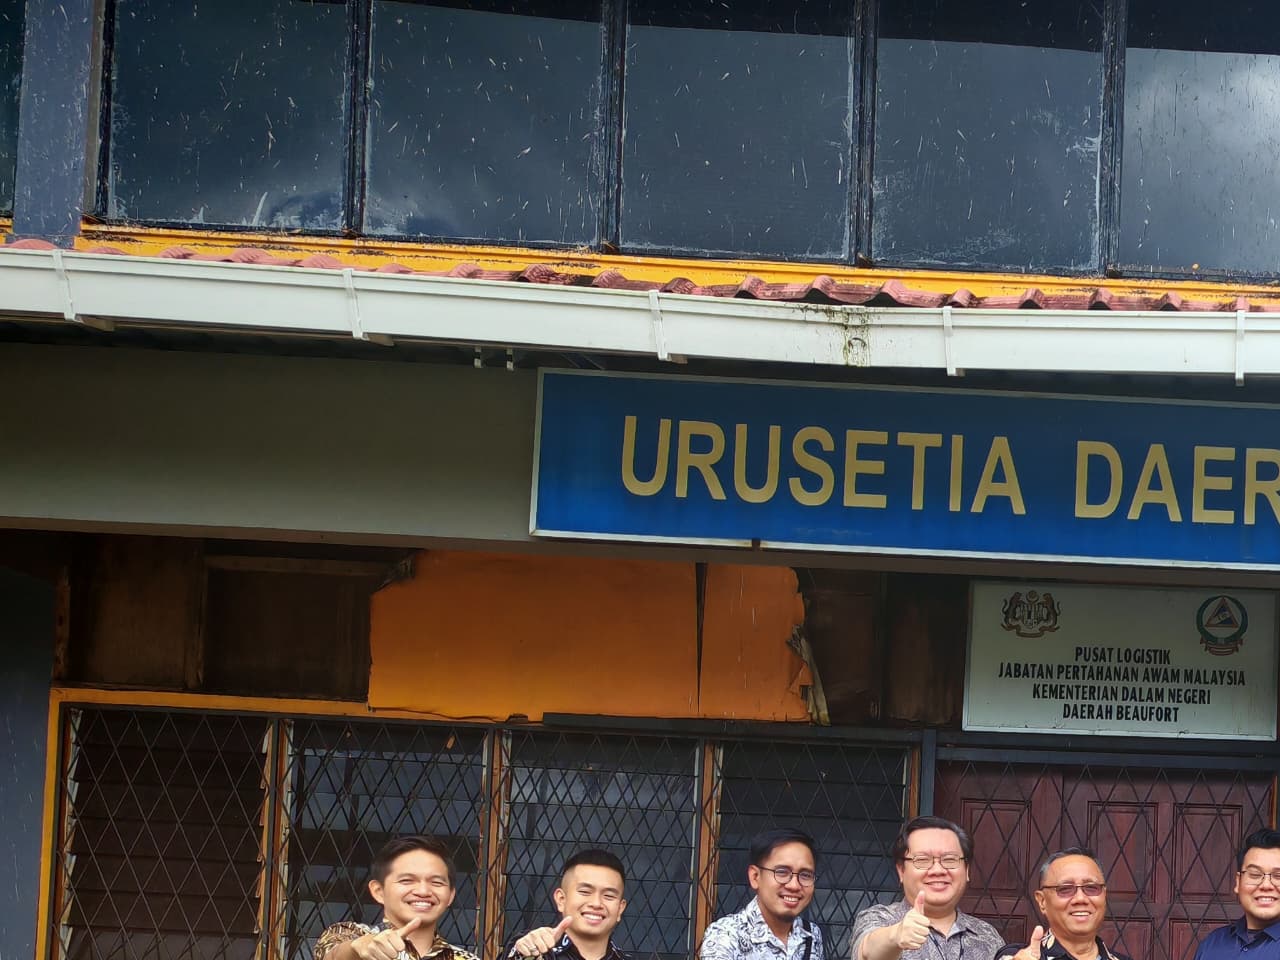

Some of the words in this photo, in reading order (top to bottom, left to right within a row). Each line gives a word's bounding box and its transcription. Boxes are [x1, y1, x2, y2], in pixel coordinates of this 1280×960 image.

[621, 415, 1026, 515] URUSETIA
[1074, 646, 1114, 663] PUSAT
[1117, 648, 1171, 665] LOGISTIK
[998, 662, 1053, 679] JABATAN
[1056, 664, 1140, 682] PERTAHANAN
[1142, 667, 1180, 684] AWAM
[1183, 669, 1246, 686] MALAYSIA
[1032, 683, 1118, 701] KEMENTERIAN
[1121, 686, 1164, 703] DALAM
[1168, 688, 1211, 705] NEGERI
[1062, 703, 1113, 720] DAERAH
[1116, 705, 1179, 722] BEAUFORT
